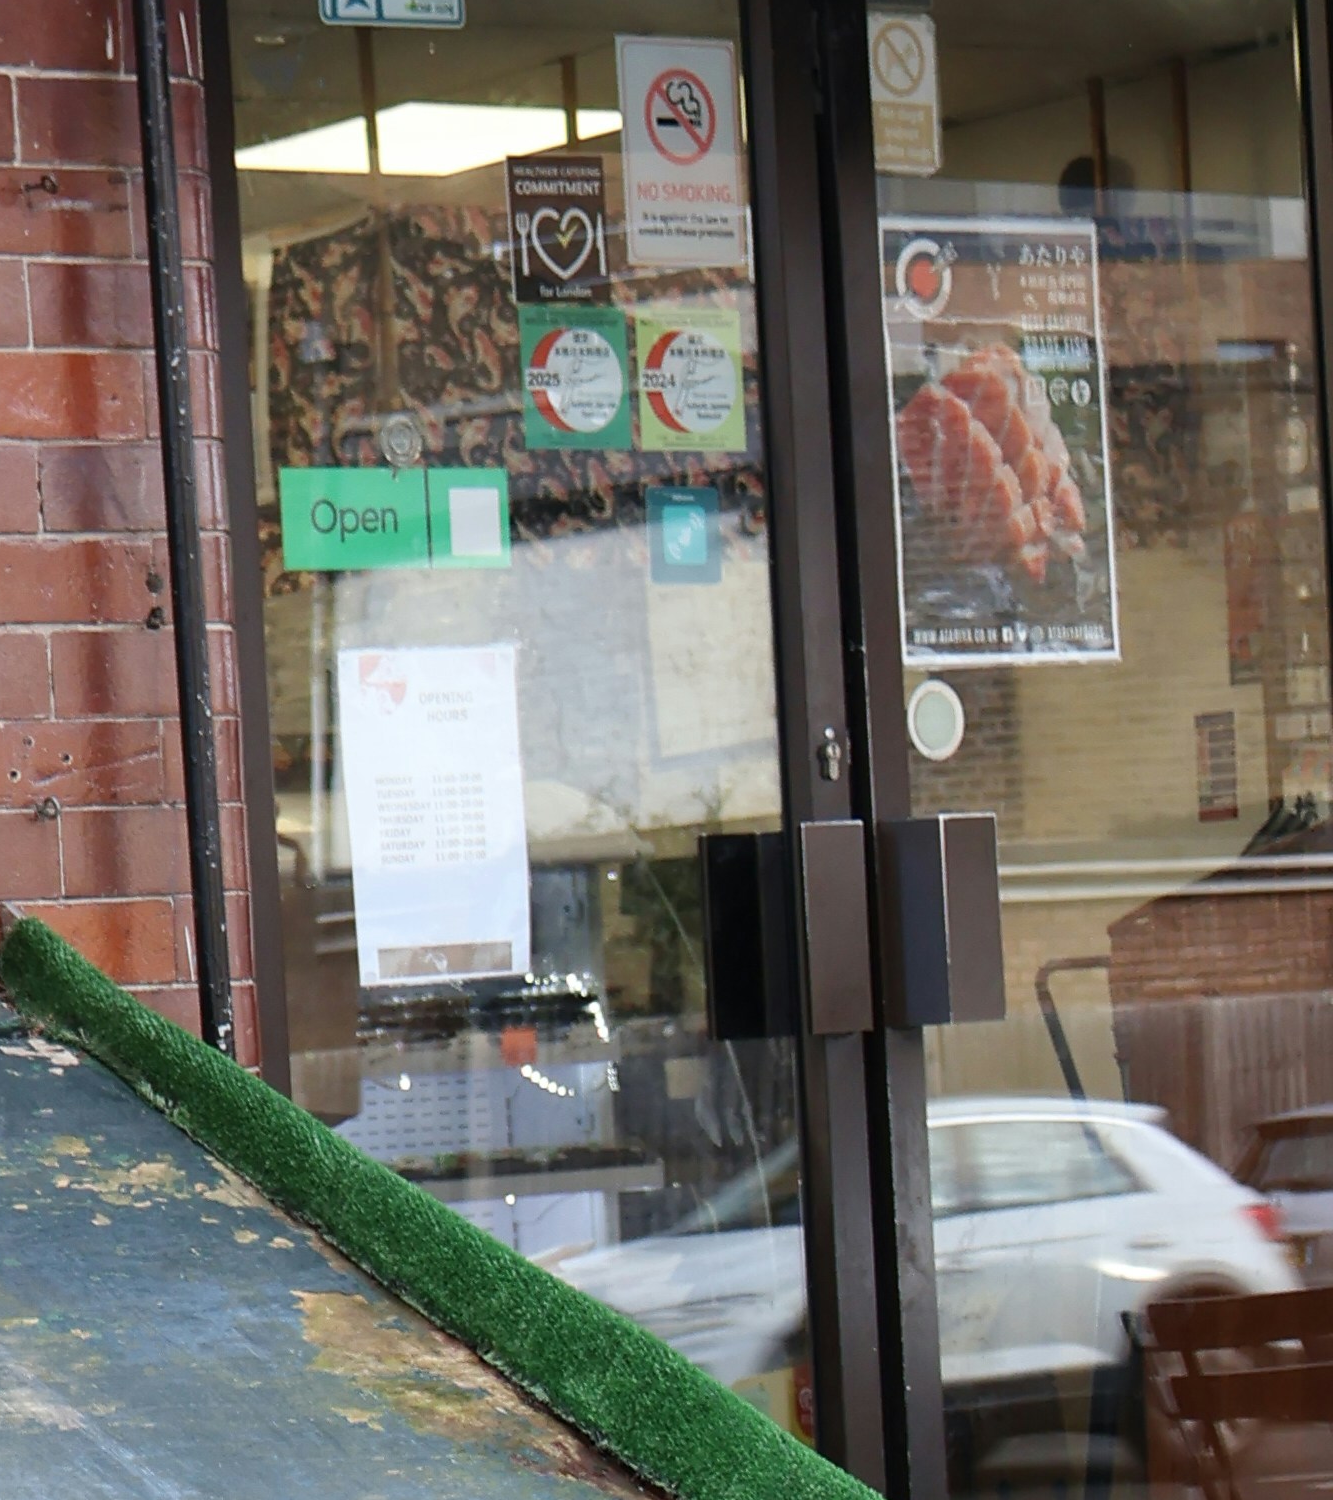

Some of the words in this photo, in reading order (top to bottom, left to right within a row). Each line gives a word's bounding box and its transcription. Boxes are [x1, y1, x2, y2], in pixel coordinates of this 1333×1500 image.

[515, 180, 601, 196] COMMITMENT
[637, 182, 658, 201] NO
[311, 498, 398, 543] Open
[419, 691, 474, 705] OPENING
[427, 707, 468, 722] HOURS
